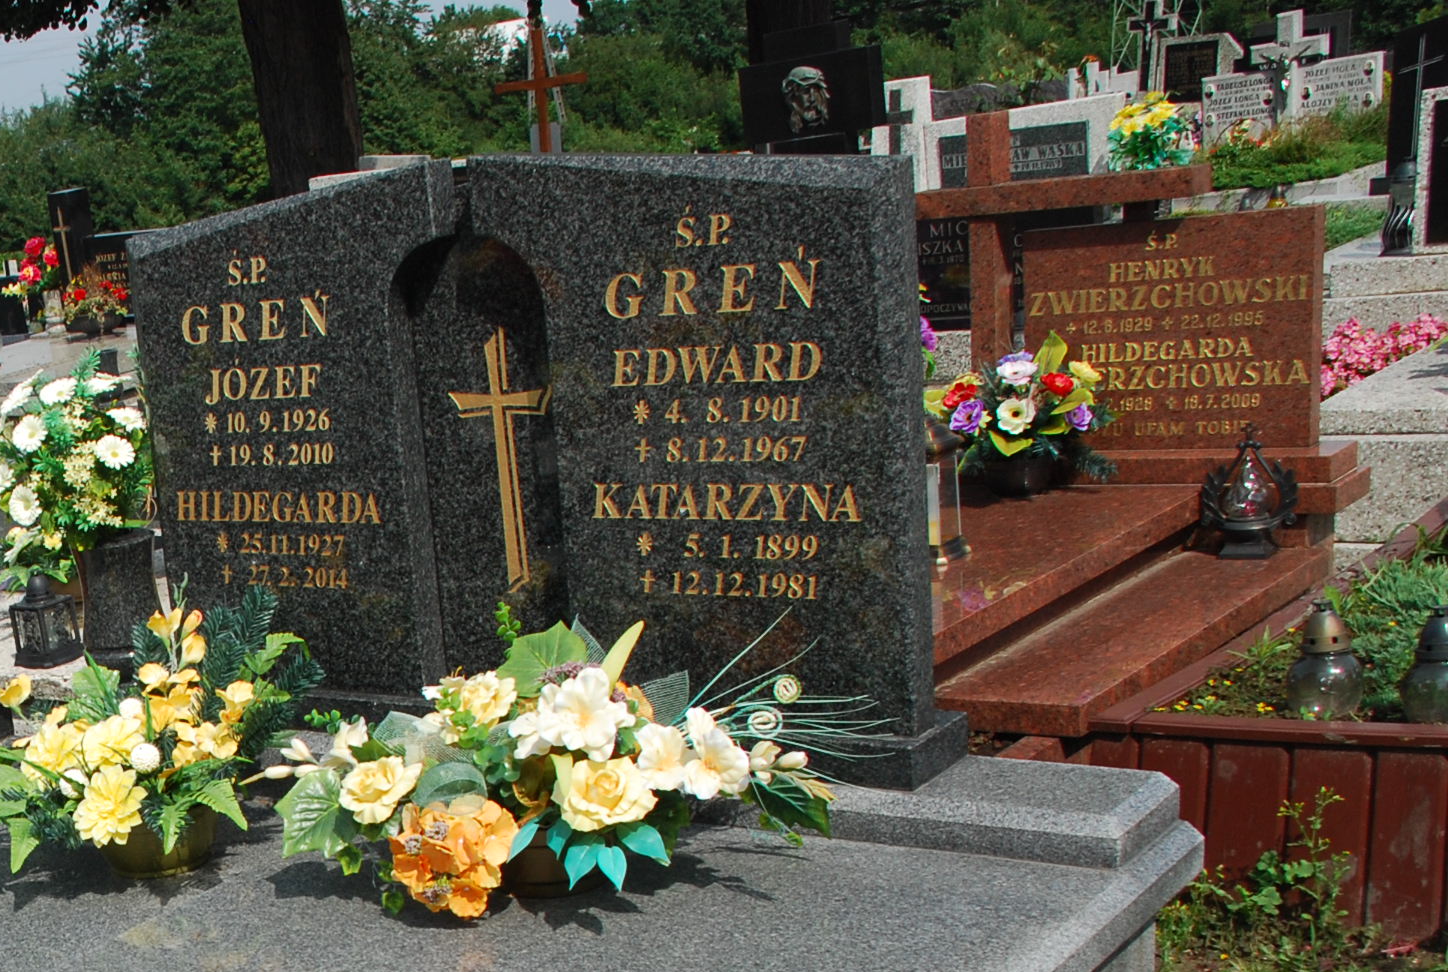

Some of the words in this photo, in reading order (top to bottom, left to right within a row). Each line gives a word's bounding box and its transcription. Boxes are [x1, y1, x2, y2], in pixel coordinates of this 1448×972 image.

[604, 246, 823, 320] GREŃ
[1109, 256, 1215, 283] HENRYK
[1029, 275, 1310, 317] ZWIERZCHOWSKI
[181, 290, 331, 347] GREŃ
[610, 341, 824, 387] EDWARD
[1082, 337, 1255, 364] HILDEGARDA
[205, 357, 322, 405] JÓZEF
[1094, 359, 1311, 391] ERZCHOWSKA
[176, 489, 381, 524] HILDEGARDA
[592, 483, 863, 523] KATARZYNA
